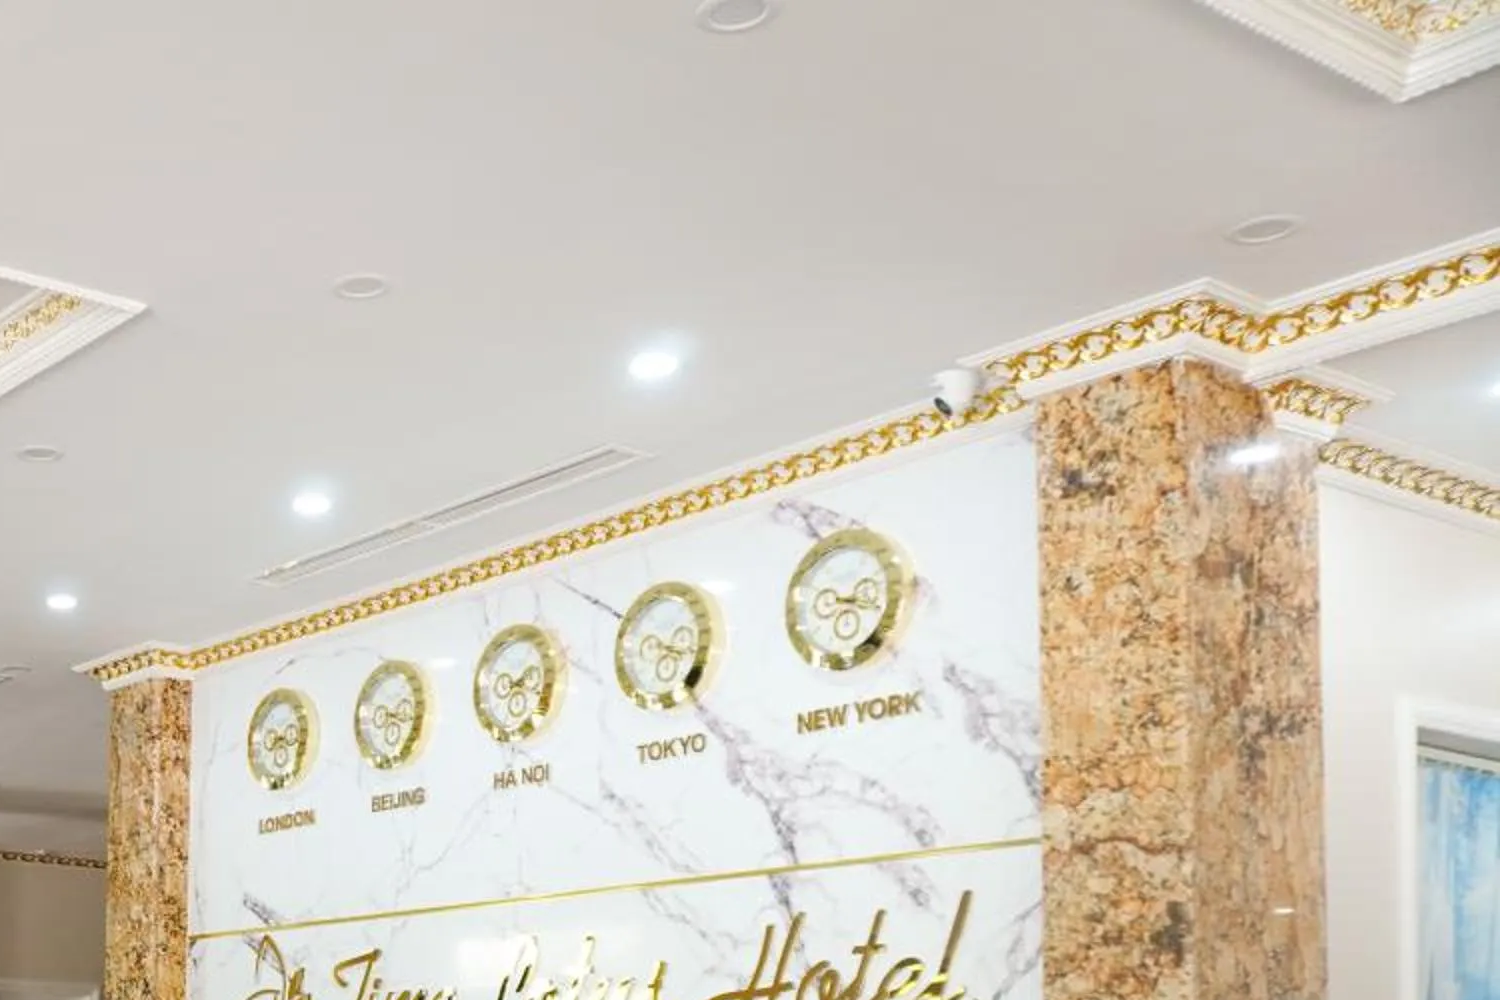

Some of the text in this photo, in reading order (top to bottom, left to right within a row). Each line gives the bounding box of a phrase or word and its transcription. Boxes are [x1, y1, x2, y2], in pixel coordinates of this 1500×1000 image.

[796, 688, 924, 735] NEW YORK
[636, 732, 707, 764] TOKYO
[371, 786, 426, 813] BEIJING
[259, 809, 316, 834] LONDON
